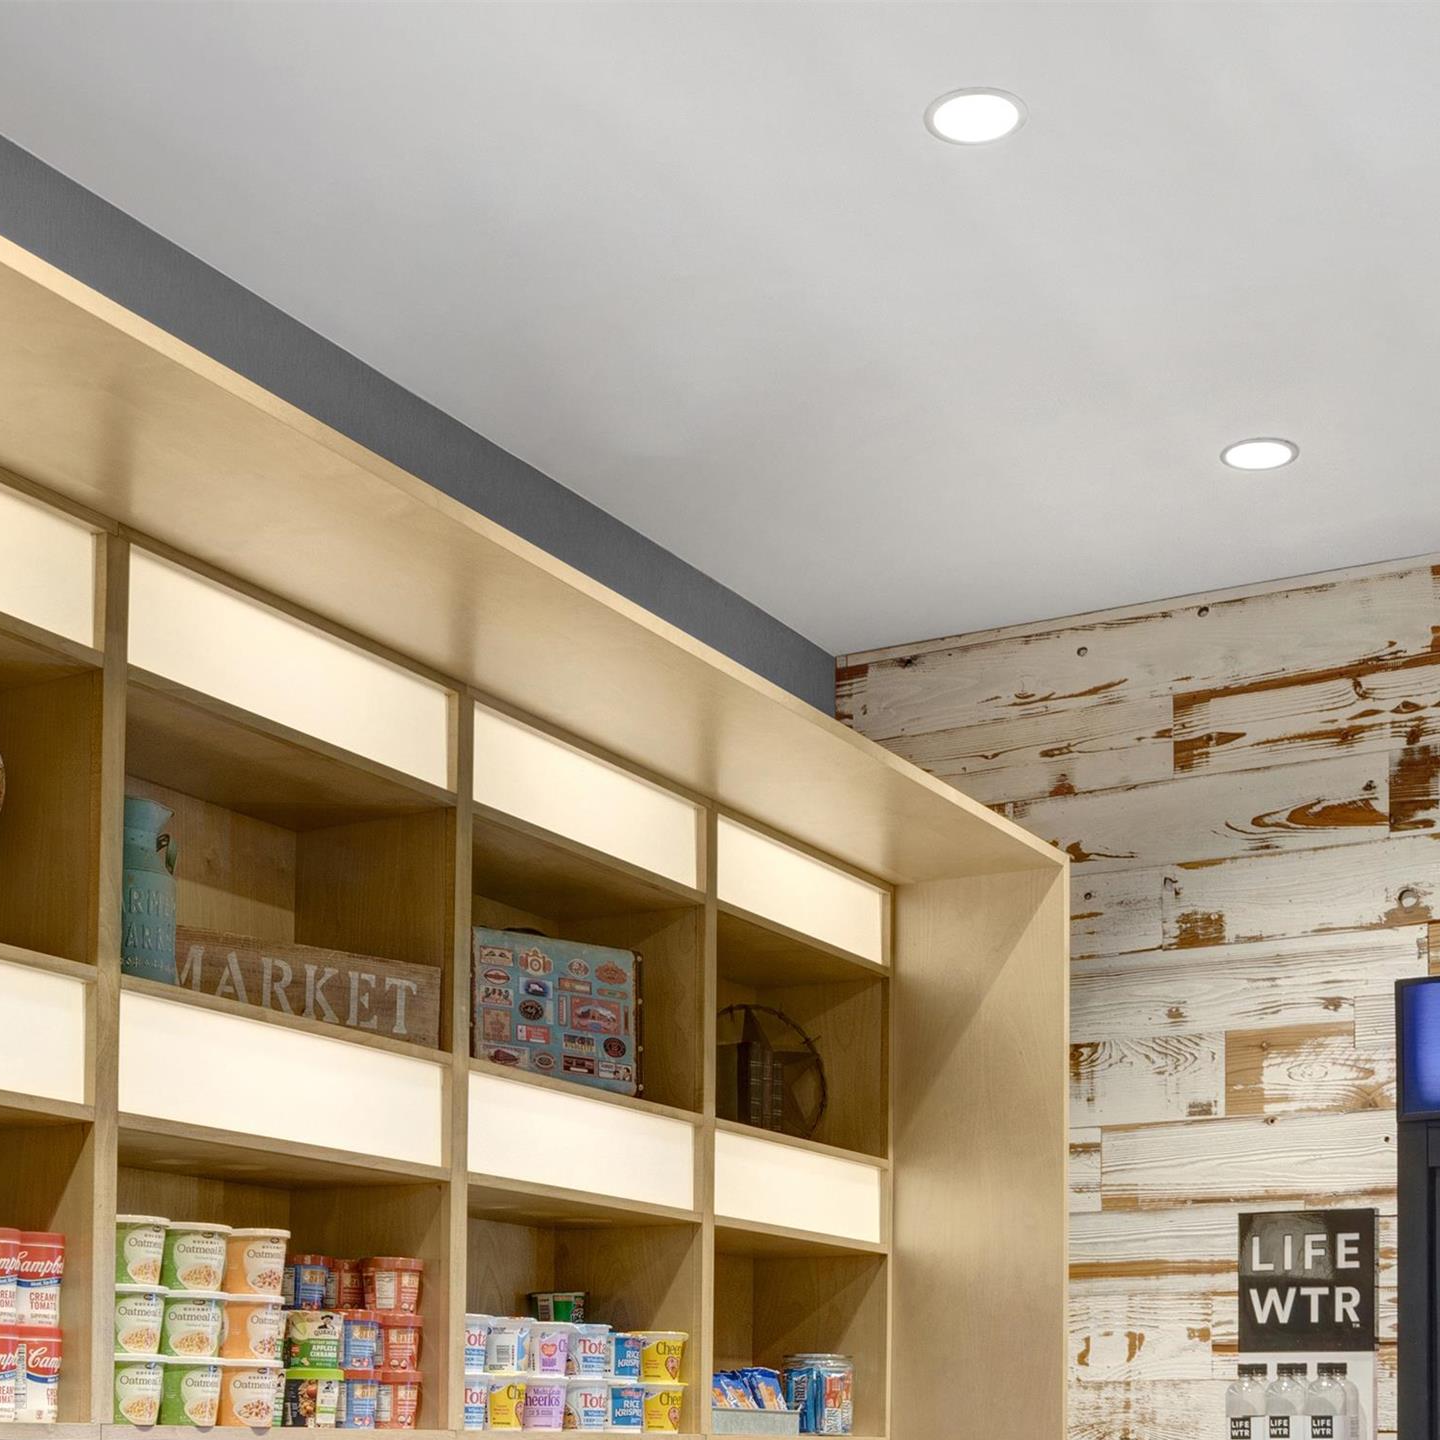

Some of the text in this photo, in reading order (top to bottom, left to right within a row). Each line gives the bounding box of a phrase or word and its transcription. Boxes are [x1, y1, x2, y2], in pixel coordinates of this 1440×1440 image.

[175, 945, 417, 1037] MARKET
[1251, 1232, 1360, 1272] LIFE
[1249, 1286, 1361, 1325] WTR
[525, 1393, 560, 1407] heerios
[1231, 1418, 1250, 1427] LIFE
[1270, 1417, 1289, 1426] LIFE
[1312, 1417, 1332, 1426] LIFE
[1231, 1428, 1250, 1437] WTR
[1270, 1427, 1289, 1436] WTR
[1312, 1427, 1332, 1436] WTR
